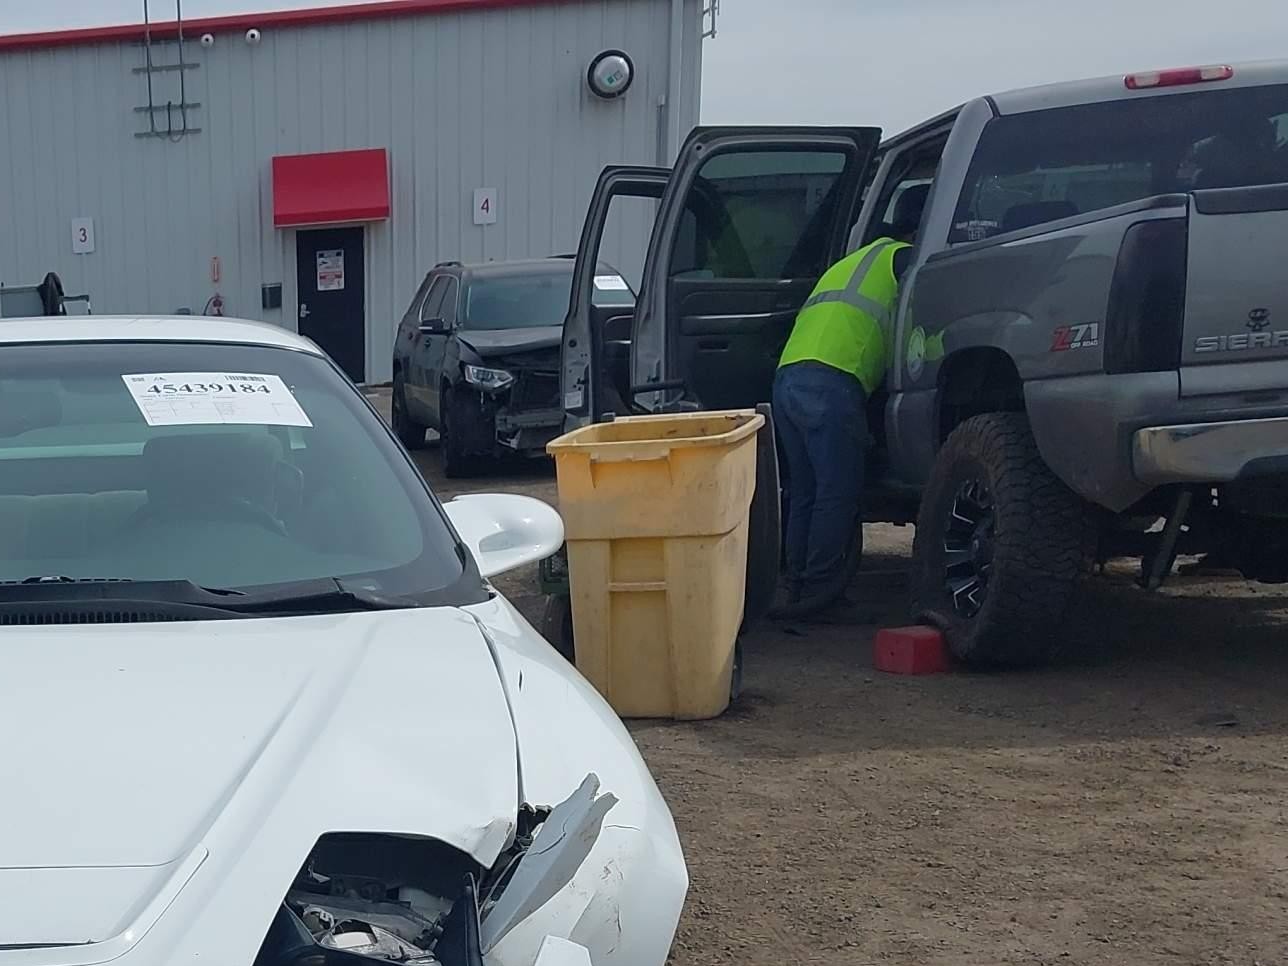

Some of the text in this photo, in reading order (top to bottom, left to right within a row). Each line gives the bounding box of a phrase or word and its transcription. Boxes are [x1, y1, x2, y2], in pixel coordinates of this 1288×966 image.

[481, 197, 490, 214] 4
[79, 227, 88, 243] 3
[1049, 322, 1098, 351] Z71
[147, 383, 272, 395] 45439184
